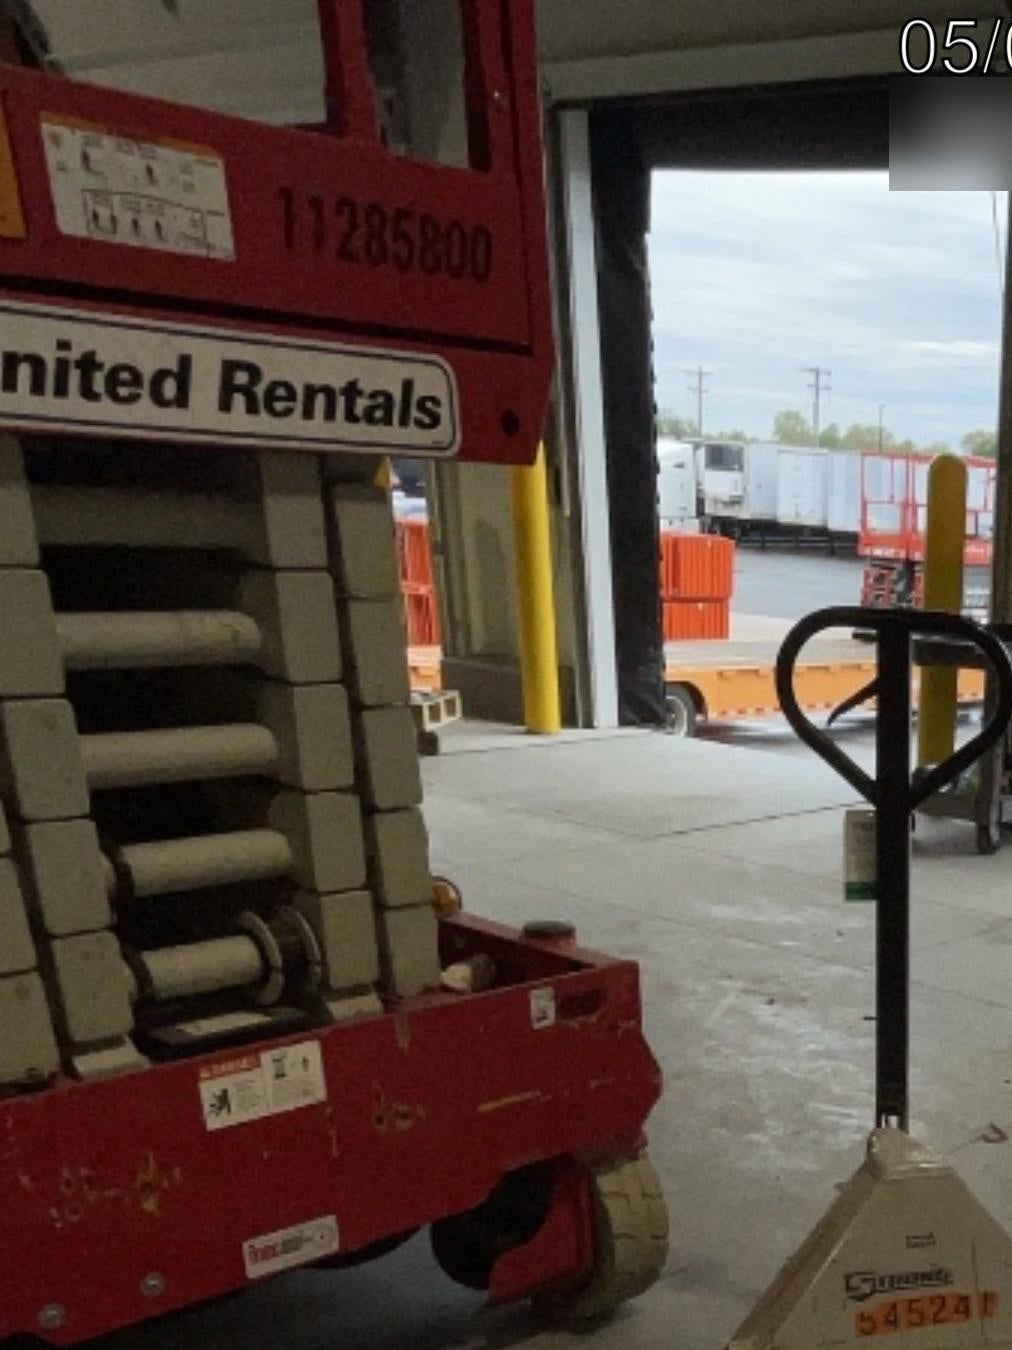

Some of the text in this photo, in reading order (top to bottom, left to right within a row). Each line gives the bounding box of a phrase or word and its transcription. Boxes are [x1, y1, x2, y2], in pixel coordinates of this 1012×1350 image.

[278, 185, 493, 283] 11285800
[0, 338, 442, 430] nited Rentals
